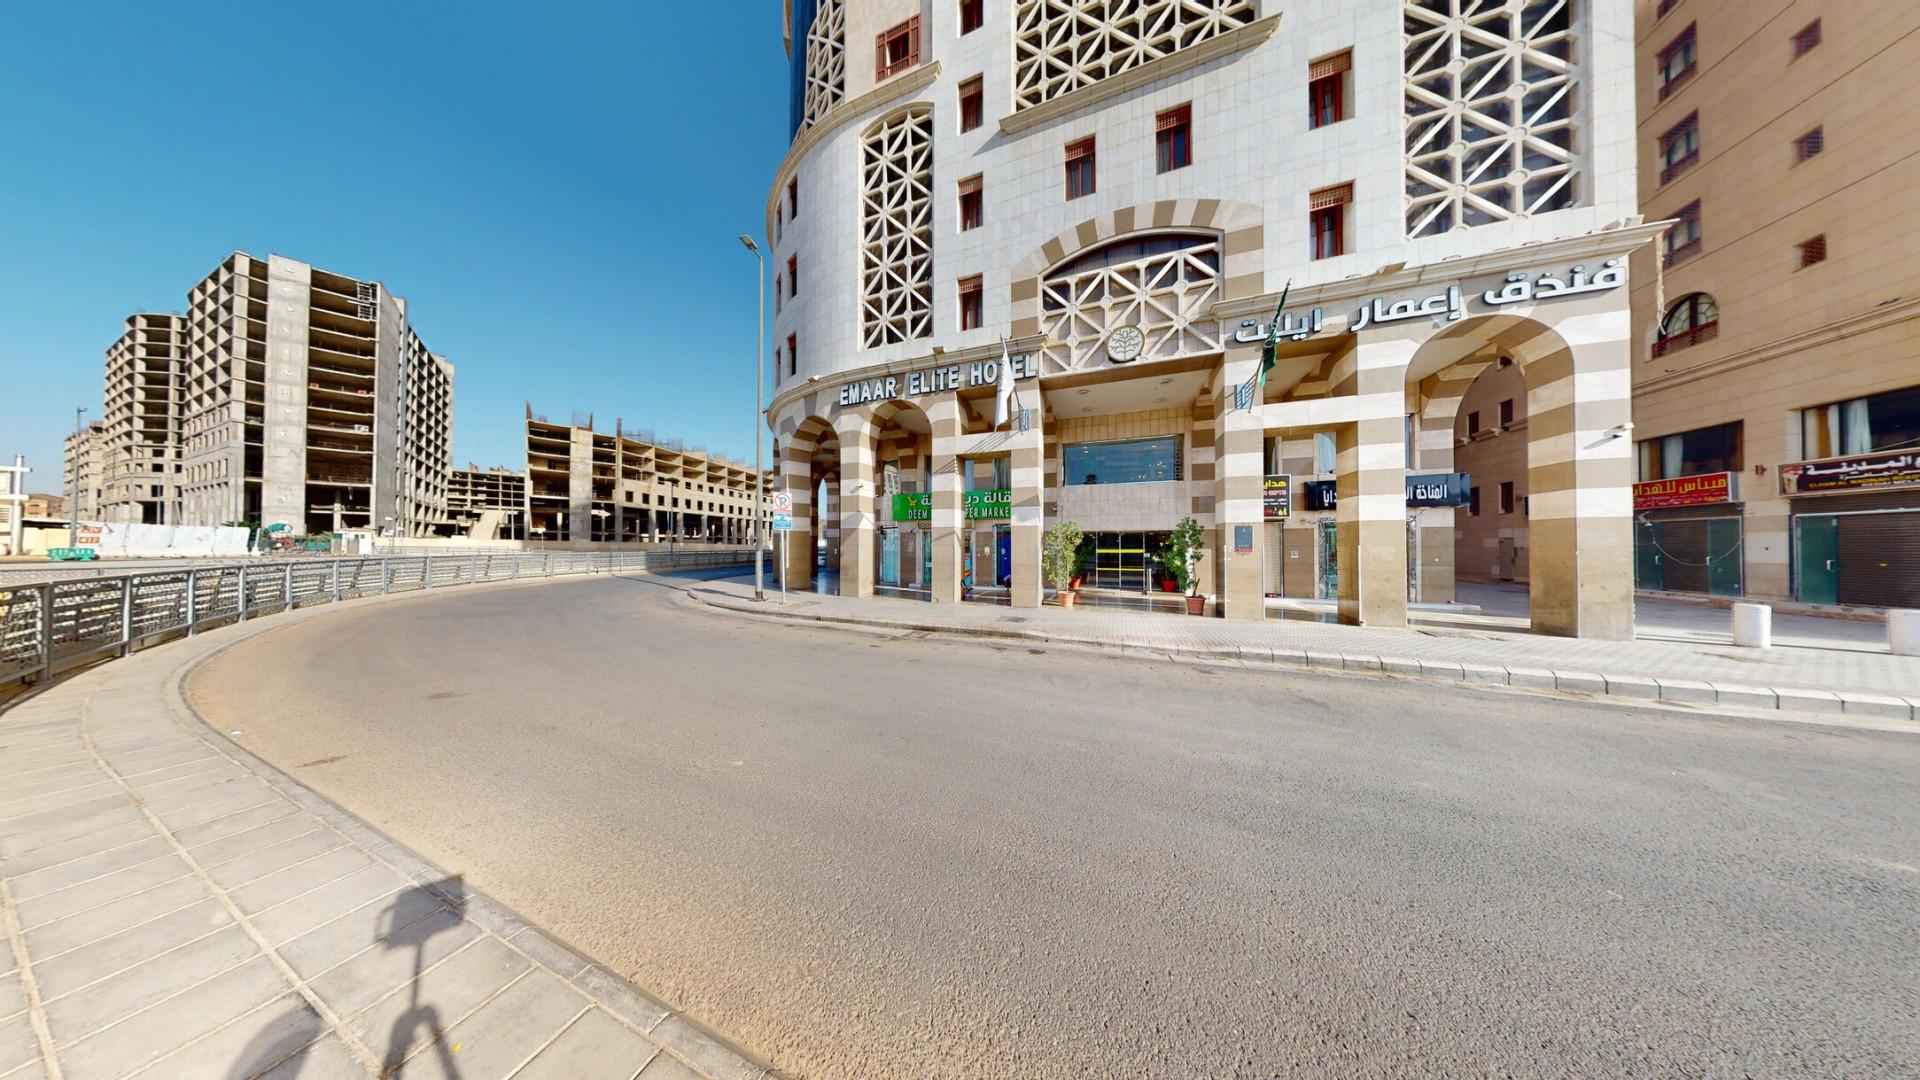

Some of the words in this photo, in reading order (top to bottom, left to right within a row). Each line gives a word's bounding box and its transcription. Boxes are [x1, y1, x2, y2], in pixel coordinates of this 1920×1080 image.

[1482, 259, 1627, 305] فندق
[1350, 284, 1462, 333] إعمار
[839, 376, 897, 406] EMAAR
[909, 364, 960, 396] ELITE
[970, 353, 1037, 387] HOEL
[908, 509, 928, 520] DEEM
[965, 507, 979, 519] PER
[982, 506, 1010, 518] MARKE
[984, 490, 1012, 503] قالة
